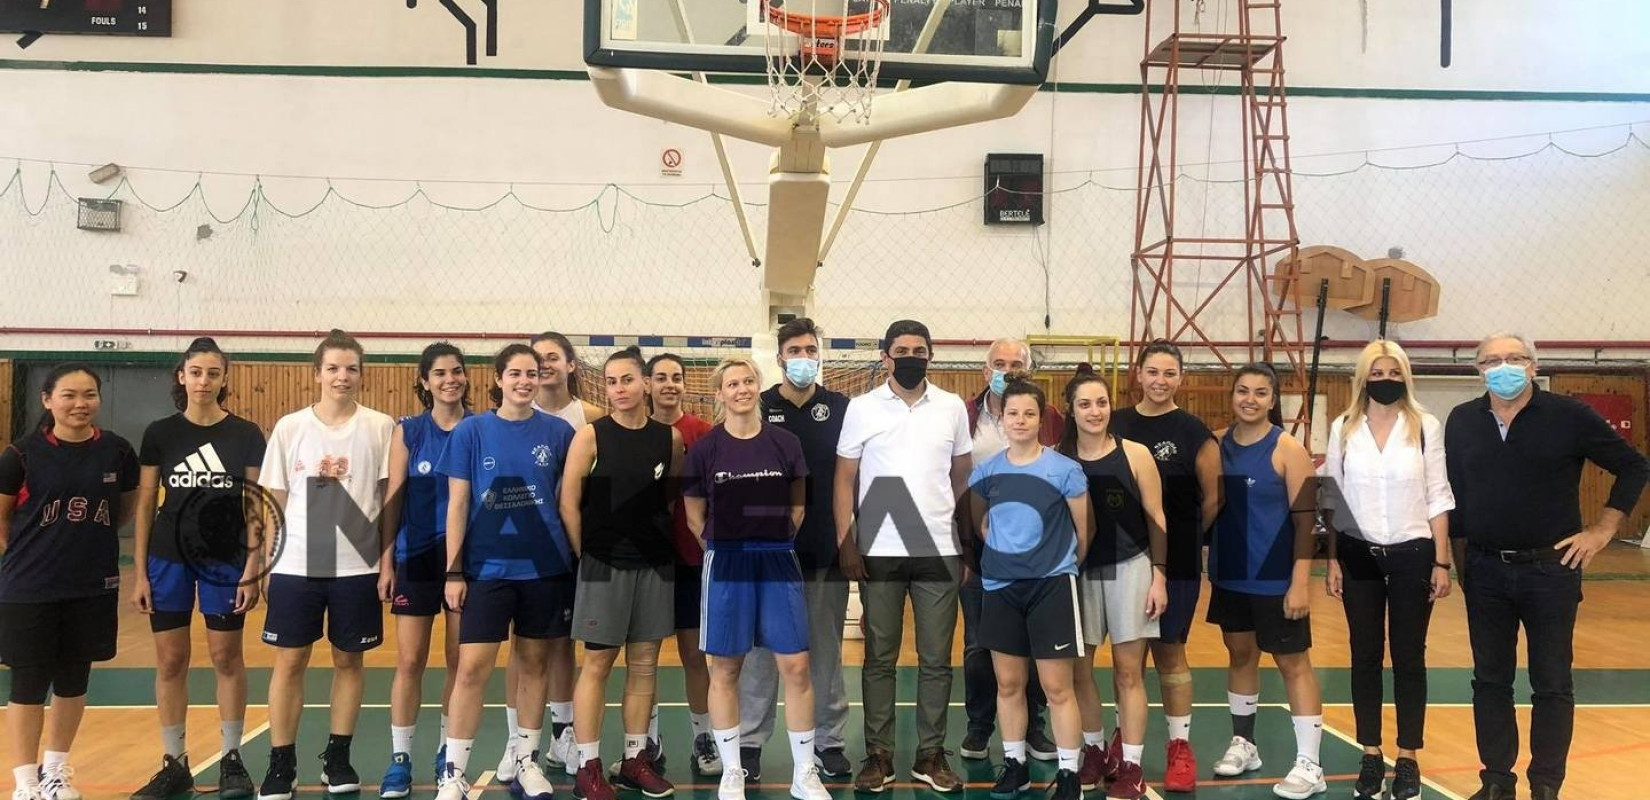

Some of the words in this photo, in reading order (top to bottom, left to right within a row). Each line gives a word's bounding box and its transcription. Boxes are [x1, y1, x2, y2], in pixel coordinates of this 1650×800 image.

[138, 6, 146, 14] 14
[91, 16, 116, 25] FOULS
[138, 22, 147, 30] 15
[768, 415, 785, 423] COACH
[168, 470, 234, 489] adidas
[714, 469, 783, 484] Champion
[39, 496, 111, 527] USA
